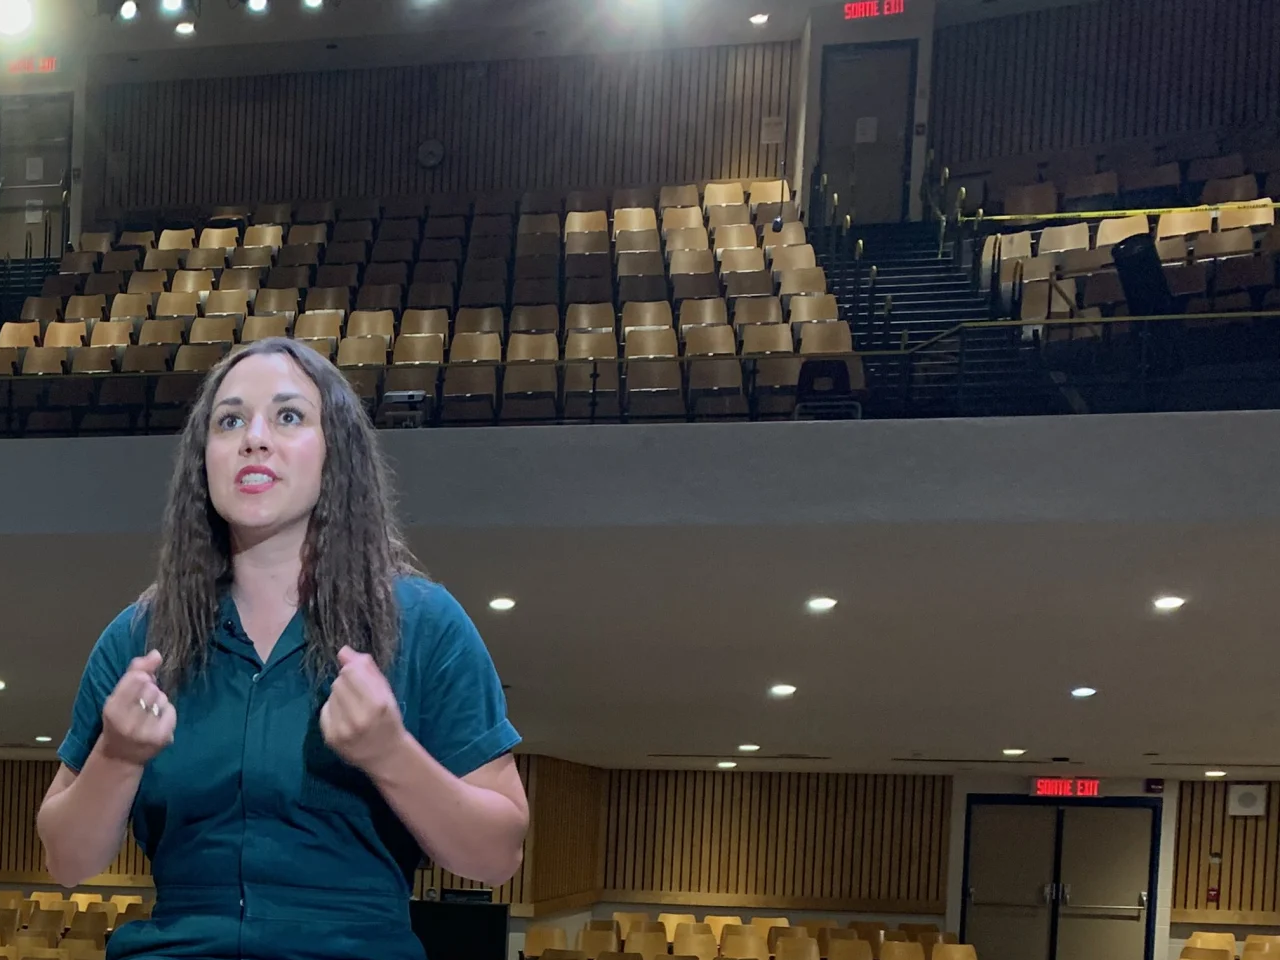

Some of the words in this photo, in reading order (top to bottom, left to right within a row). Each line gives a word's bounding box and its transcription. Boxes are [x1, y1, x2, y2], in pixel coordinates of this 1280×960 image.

[844, 1, 880, 20] SORTIE
[1037, 779, 1072, 796] SORTIE
[1077, 780, 1099, 796] EXIT
